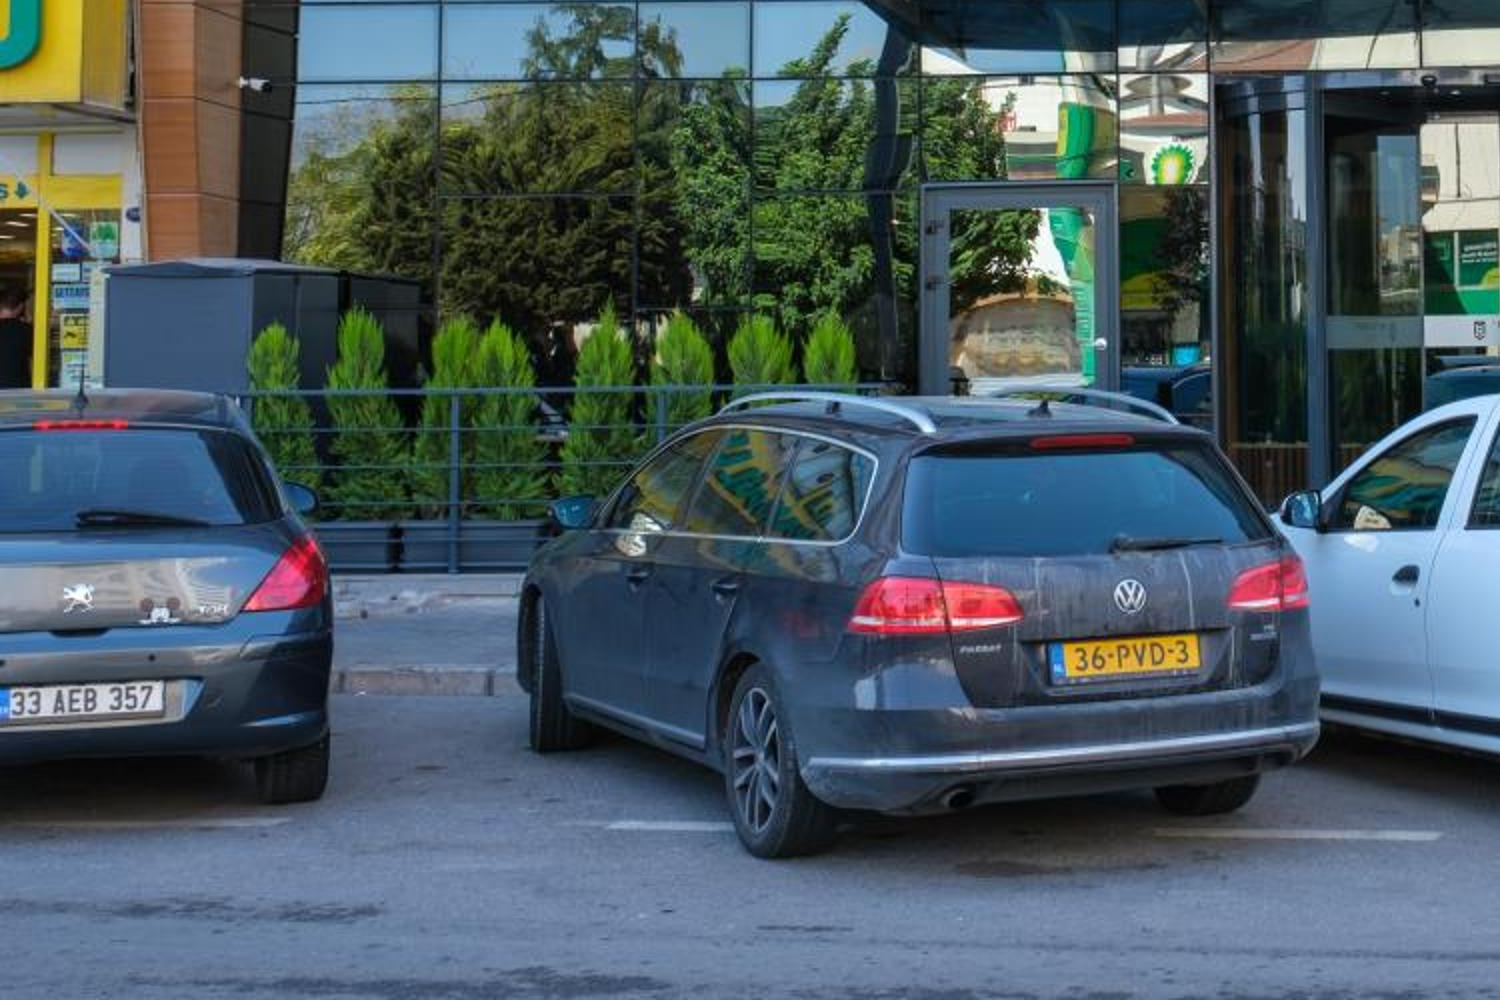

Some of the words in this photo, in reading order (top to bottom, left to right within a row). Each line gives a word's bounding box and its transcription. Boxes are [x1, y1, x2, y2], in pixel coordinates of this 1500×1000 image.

[1075, 640, 1190, 672] 36-PVD-3
[11, 691, 41, 716] 33
[53, 688, 97, 714] AEB
[109, 685, 153, 711] 357
